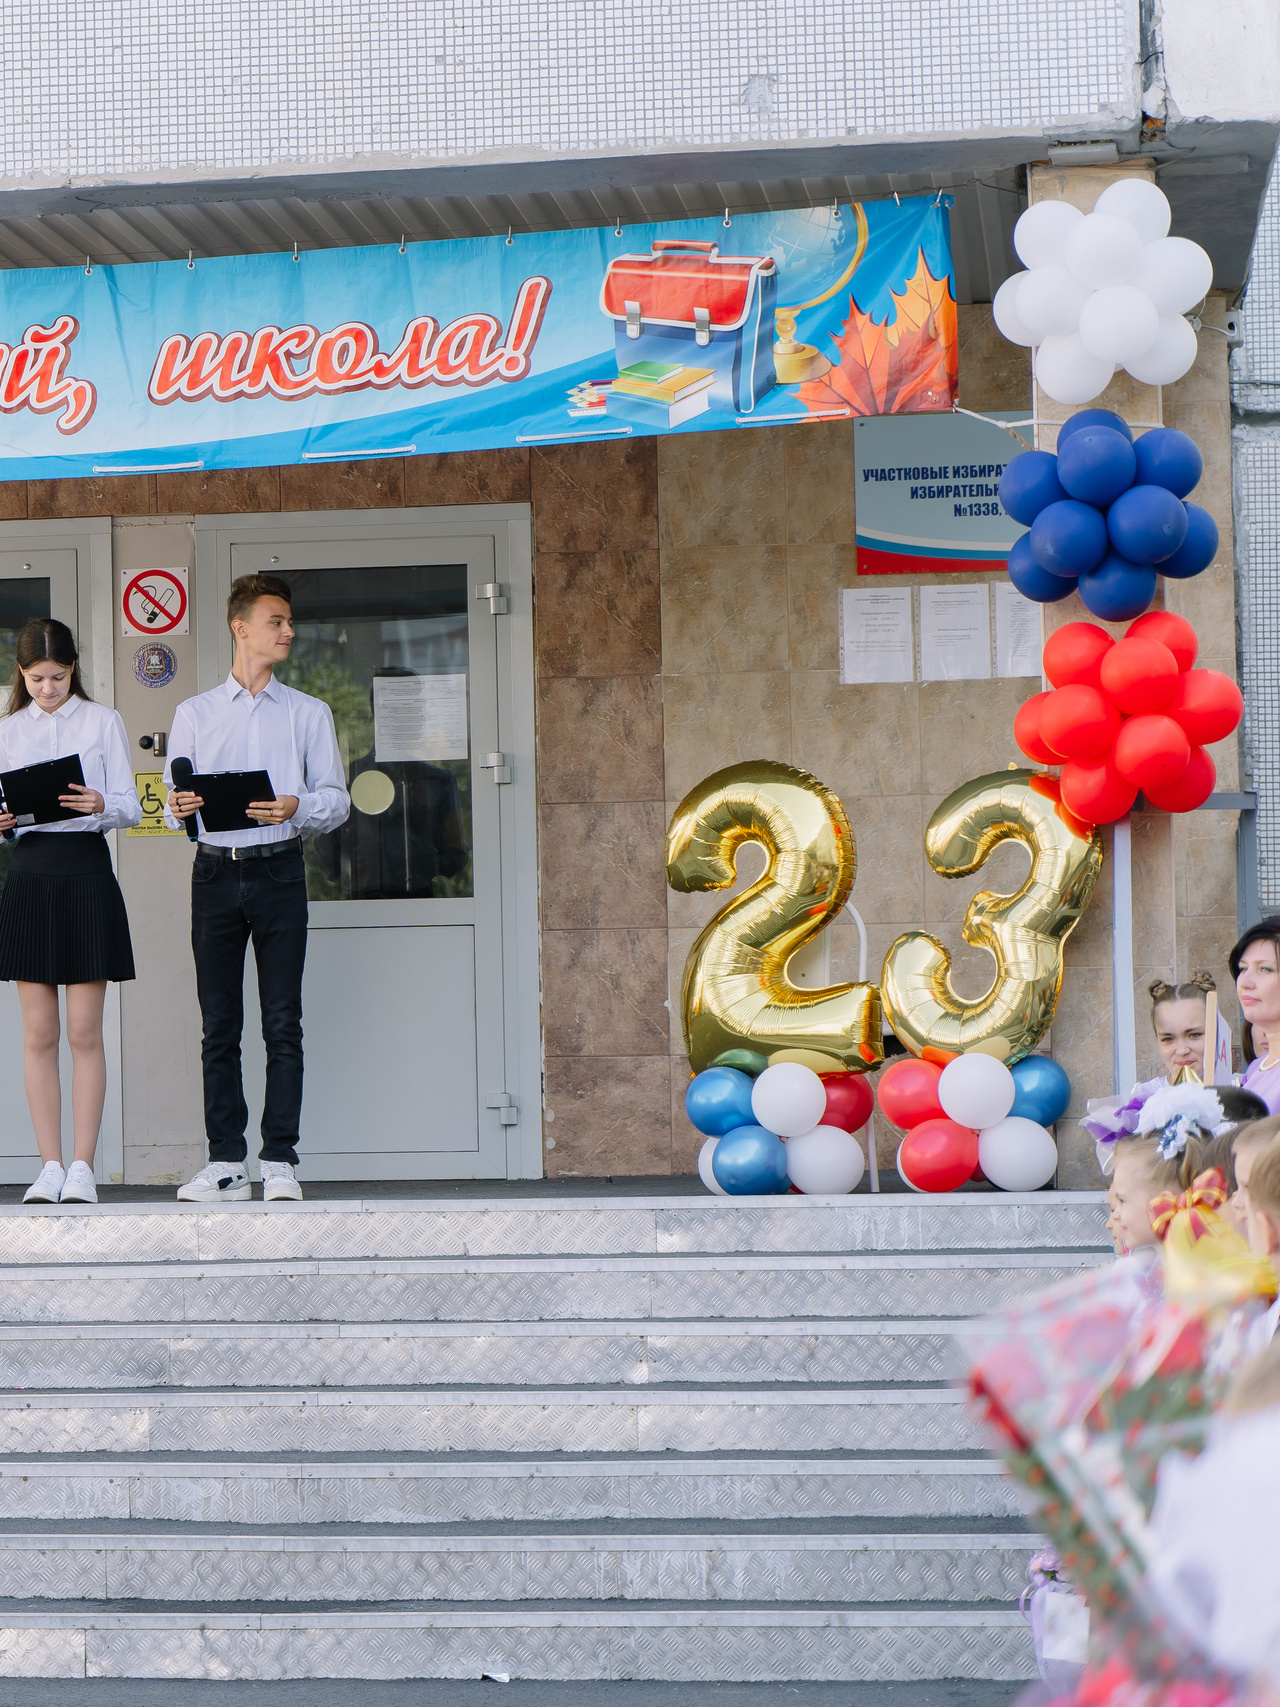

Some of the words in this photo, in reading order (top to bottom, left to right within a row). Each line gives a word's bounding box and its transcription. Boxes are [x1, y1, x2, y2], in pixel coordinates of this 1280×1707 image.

[148, 275, 553, 406] школа!
[862, 465, 950, 482] УЧАСТКОВЫЕ
[953, 502, 1002, 517] №1338,
